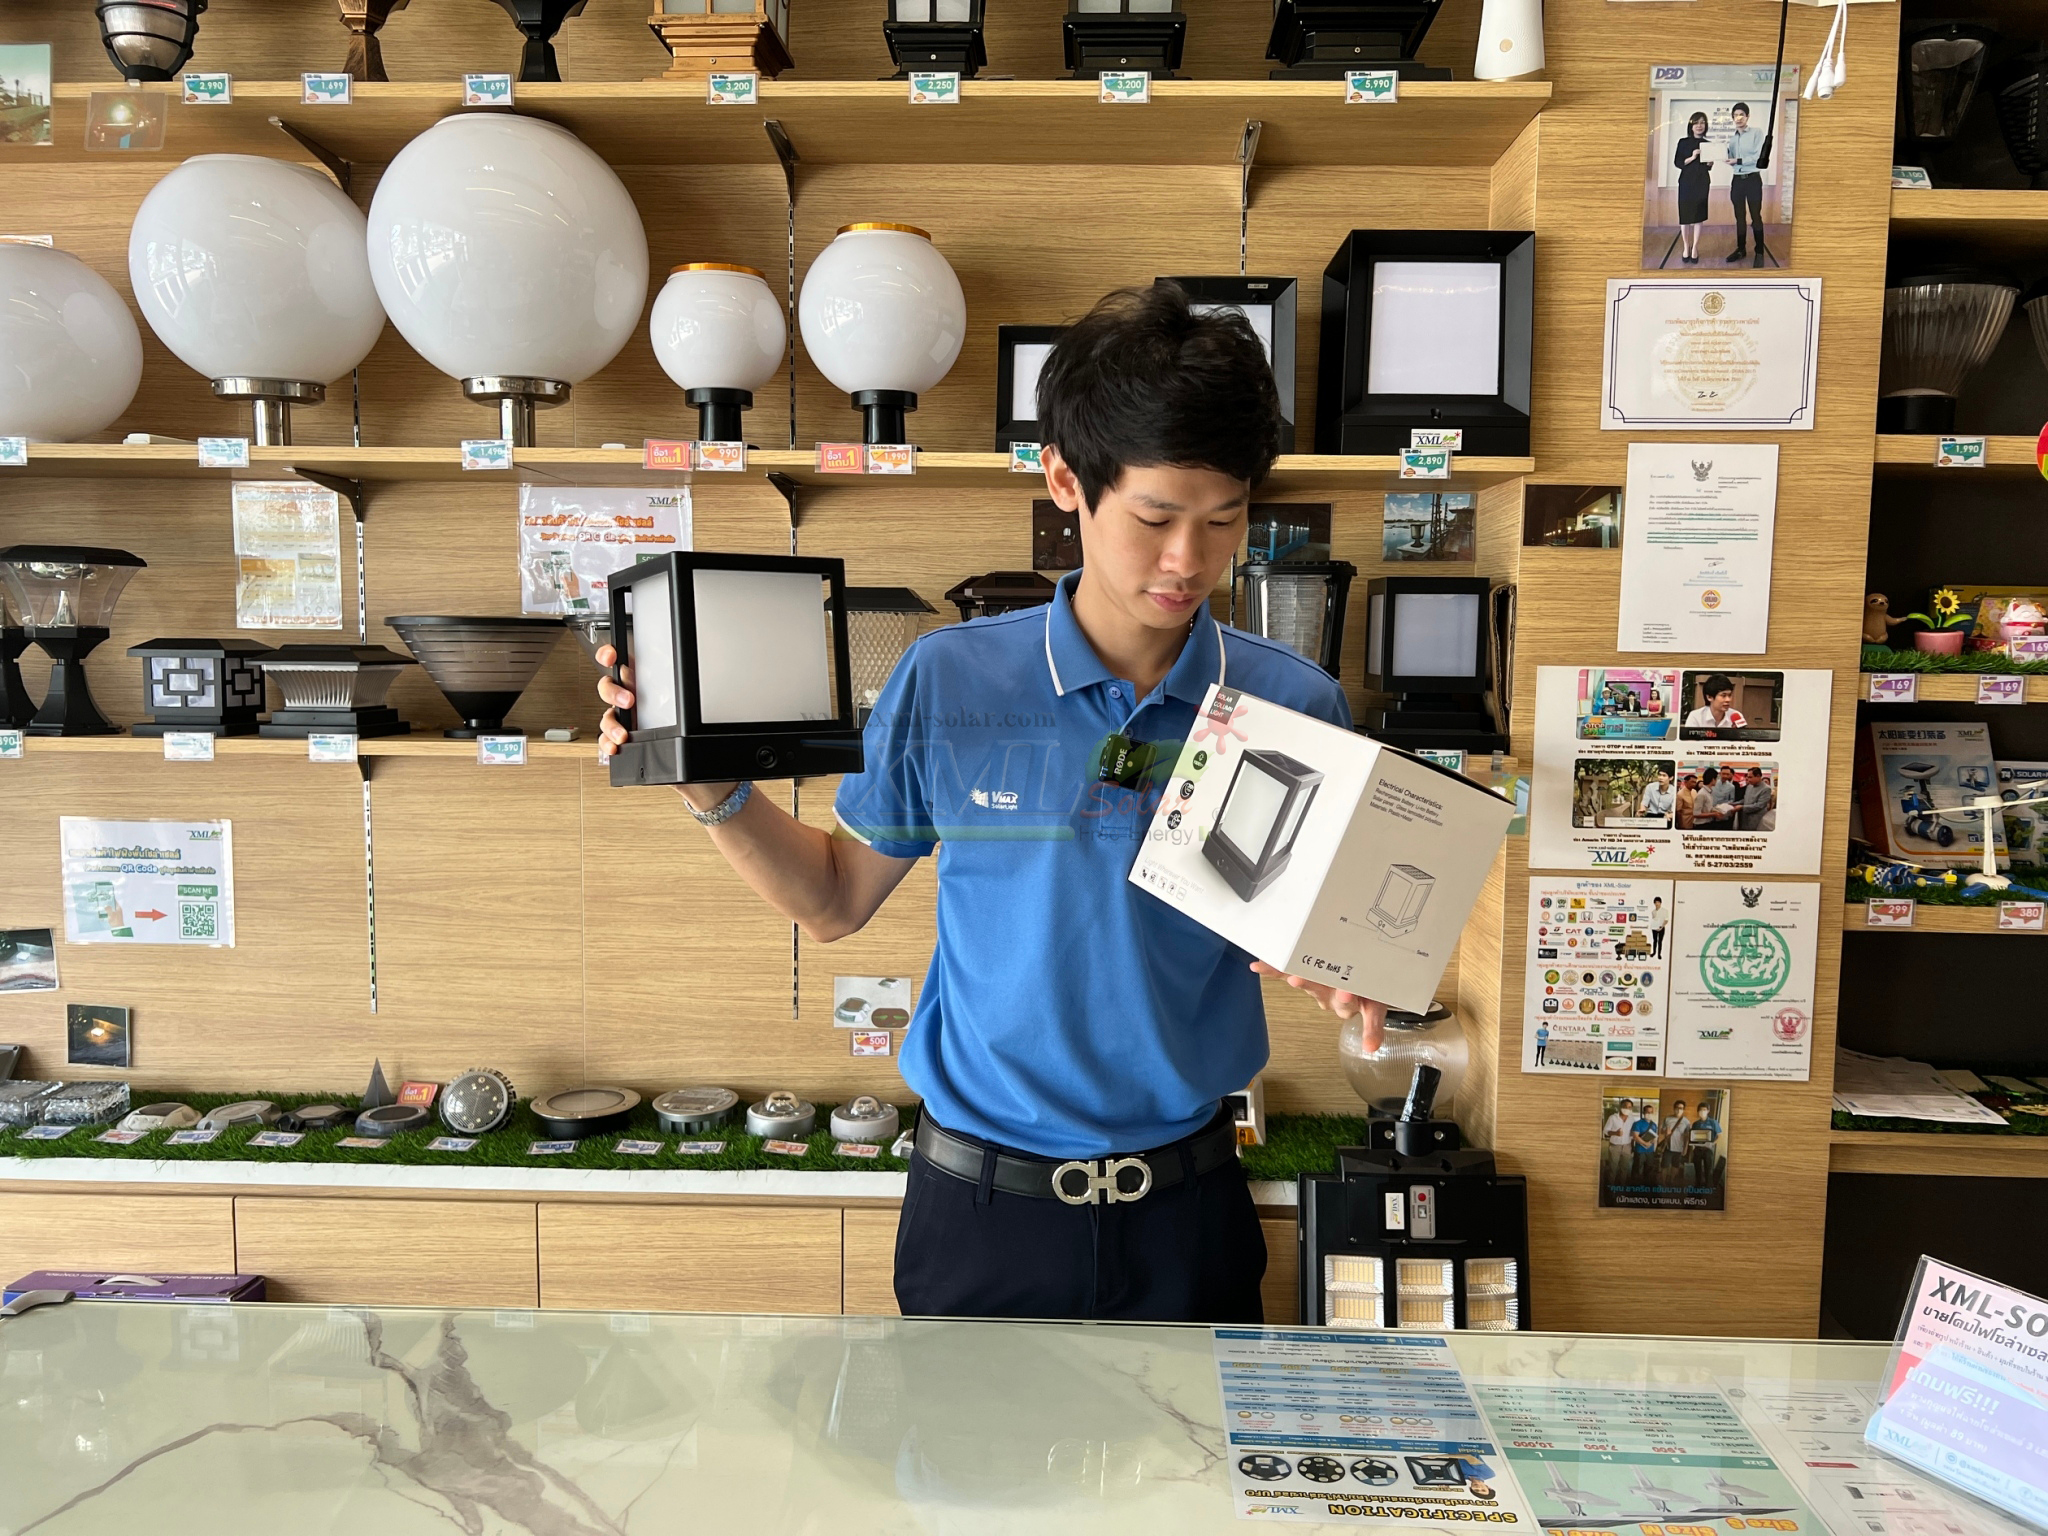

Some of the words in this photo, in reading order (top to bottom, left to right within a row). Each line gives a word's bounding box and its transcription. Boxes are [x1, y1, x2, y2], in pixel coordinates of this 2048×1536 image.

[200, 81, 223, 91] 2,990
[321, 81, 344, 91] 1,699
[483, 82, 506, 91] 1,699
[725, 82, 750, 92] 3,200
[928, 81, 952, 90] 2,250
[1117, 80, 1142, 90] 3,200
[1365, 79, 1390, 89] 5,990
[1416, 436, 1443, 445] XML
[719, 448, 739, 458] 990
[1955, 444, 1980, 454] 1,990
[884, 451, 907, 462] 1,990
[1418, 456, 1442, 465] 2,890
[2031, 642, 2048, 652] 169
[1891, 680, 1910, 690] 169
[1999, 682, 2019, 691] 169
[1217, 692, 1233, 703] SOLAR
[1213, 700, 1234, 713] COLUMN
[1209, 708, 1224, 718] LIGHT
[497, 744, 519, 753] 1,590
[1438, 757, 1457, 767] 999
[1373, 794, 1383, 803] Solar
[1378, 778, 1404, 794] Electrical
[1403, 789, 1443, 811] Characteristics:
[1592, 851, 1629, 862] XML
[120, 864, 134, 874] QR
[136, 864, 158, 874] Code
[1180, 876, 1190, 887] You
[1190, 882, 1205, 894] Want
[183, 887, 201, 895] SCAN
[202, 887, 213, 895] ME
[1888, 905, 1908, 914] 299
[2019, 908, 2039, 918] 380
[1339, 916, 1348, 924] PIR
[1416, 949, 1430, 959] Switch
[1302, 954, 1313, 965] CE
[1326, 963, 1342, 974] RoHS
[1552, 1024, 1586, 1032] CENTARA
[869, 1037, 886, 1045] 500
[1950, 1428, 1965, 1442] 89
[1513, 1441, 1555, 1449] 10,000
[1458, 1446, 1485, 1455] Model
[1534, 1451, 1543, 1459] L
[1741, 1459, 1769, 1467] Size
[1244, 1489, 1271, 1498] UFO
[1266, 1505, 1299, 1515] XML
[1327, 1503, 1519, 1524] SPECIFICATION
[1725, 1517, 1747, 1530] S
[1747, 1518, 1799, 1532] Size
